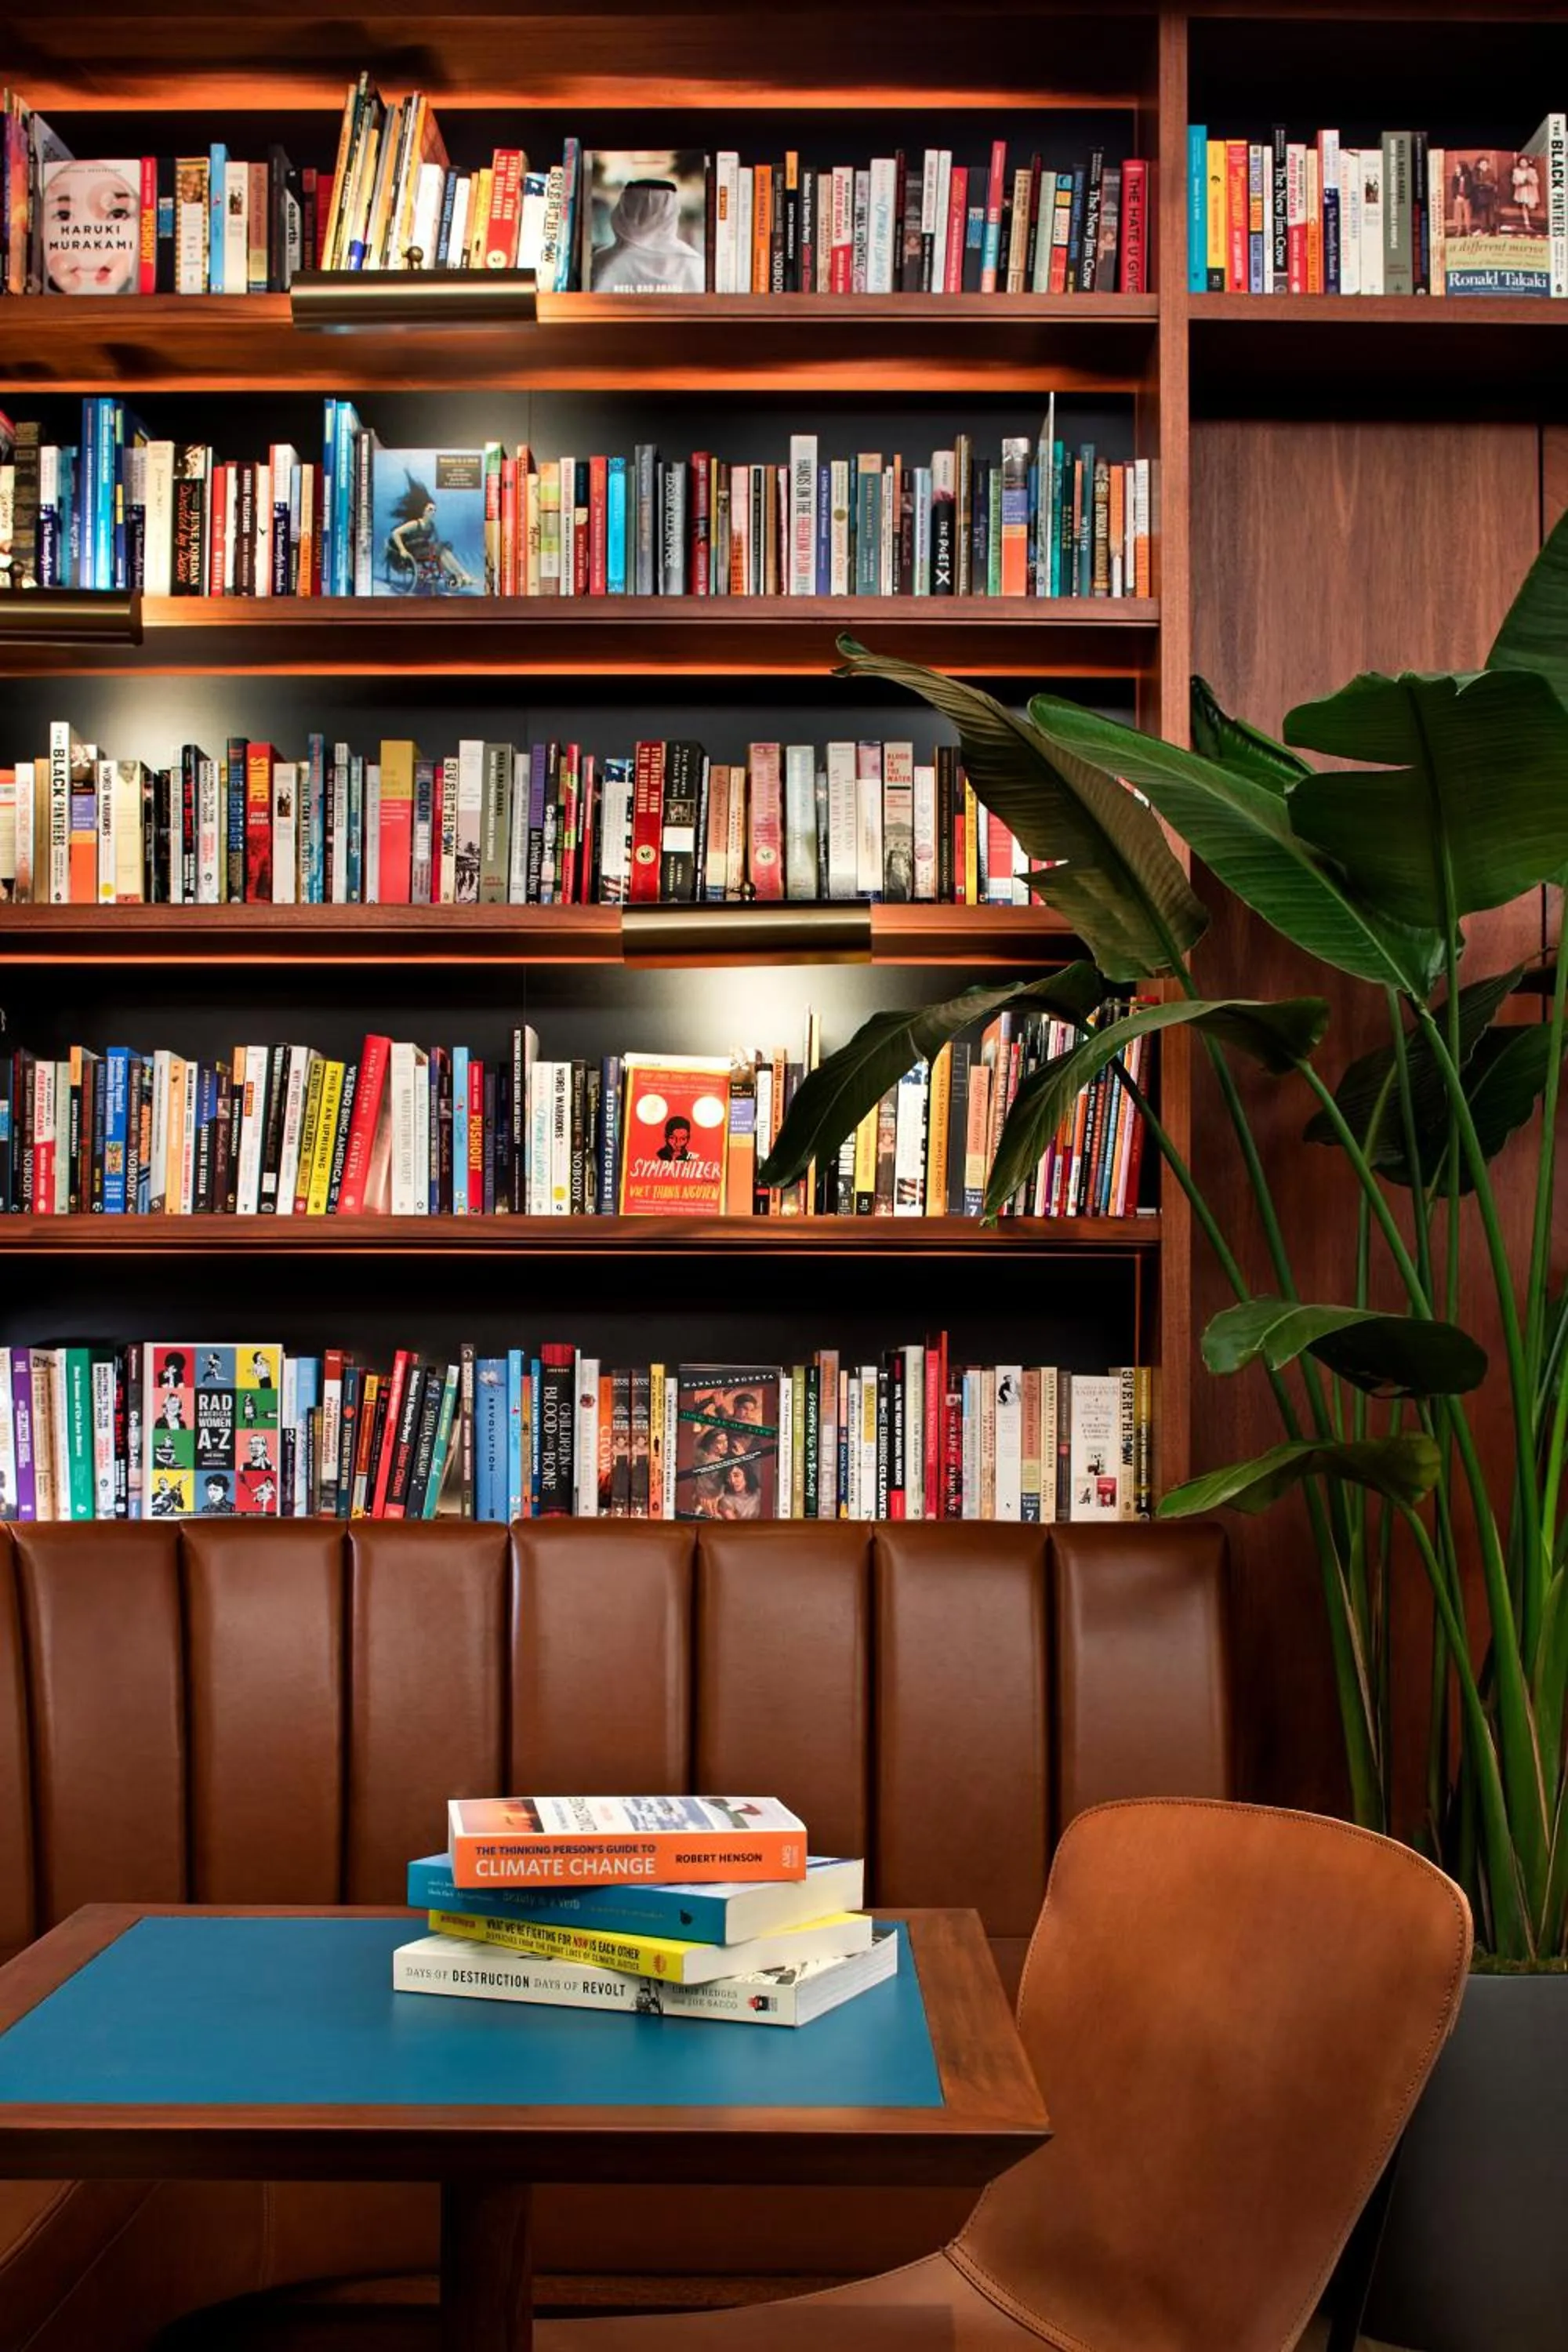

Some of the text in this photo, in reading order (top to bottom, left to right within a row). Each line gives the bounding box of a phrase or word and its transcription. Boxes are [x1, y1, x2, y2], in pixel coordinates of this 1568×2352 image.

[1551, 140, 1564, 189] BLACK
[1128, 176, 1139, 203] THE
[60, 225, 121, 236] HARUKI
[1128, 207, 1139, 241] HATE
[1274, 167, 1287, 267] The New Jim Crow
[1552, 192, 1565, 238] PANTHERS
[49, 240, 133, 251] MURAKAMI
[141, 208, 154, 264] PUSHOUT
[1082, 189, 1100, 290] The New Jim Crow
[1128, 246, 1139, 256] U
[1449, 271, 1547, 289] Ronald Takaki
[796, 459, 811, 485] HANDS
[796, 488, 811, 498] ON
[796, 500, 811, 514] THE
[190, 510, 200, 586] JUNE JORDAN
[1080, 516, 1090, 551] white
[935, 569, 951, 586] X
[53, 749, 65, 846] BLACK PANTHERS
[103, 766, 111, 790] WORD
[249, 757, 269, 802] STRIKE!
[637, 747, 649, 813] THE BEGINNING
[649, 747, 661, 814] STAMPED FROM
[228, 764, 244, 851] THE HERITAGE
[417, 781, 430, 821] COLOR
[36, 1068, 45, 1137] PUERTO RICANS
[318, 1069, 338, 1170] THIS IS AN UPRISING
[339, 1108, 352, 1134] SING
[554, 1068, 564, 1138] WORD WARRIORS
[332, 1134, 348, 1184] AMERICA
[470, 1115, 482, 1171] PUSHOUT
[604, 1089, 615, 1200] HIDDEN FIGURES
[23, 1149, 34, 1200] NOBODY
[127, 1149, 138, 1200] NOBODY
[572, 1150, 583, 1202] NOBODY
[629, 1158, 721, 1178] SYMPATHIZER
[629, 1186, 650, 1200] VIET
[198, 1394, 234, 1410] RAD
[325, 1396, 334, 1419] Fred
[543, 1385, 557, 1434] BLOOD
[1121, 1370, 1134, 1467] OVERTHROW
[197, 1428, 231, 1450] A-Z
[198, 1417, 232, 1428] WOMEN
[557, 1403, 572, 1465] CHILDREN
[542, 1450, 557, 1490] BONE
[948, 1466, 957, 1512] NANKING
[879, 1465, 887, 1519] CLEAVER
[476, 1844, 656, 1856] THE THINKING PERSON'S GUIDE TO
[476, 1857, 656, 1877] CLIMATE CHANGE
[675, 1853, 763, 1864] ROBERT HENSON
[557, 1932, 572, 1944] FOR
[589, 1939, 597, 1951] IS
[598, 1940, 615, 1955] EACH
[617, 1944, 640, 1959] OTHER
[406, 1966, 626, 1997] DAYS OF DESTRUCTION DAYS OF REVOLT
[702, 1987, 738, 1998] HEDGES
[707, 2000, 739, 2009] SACCO
